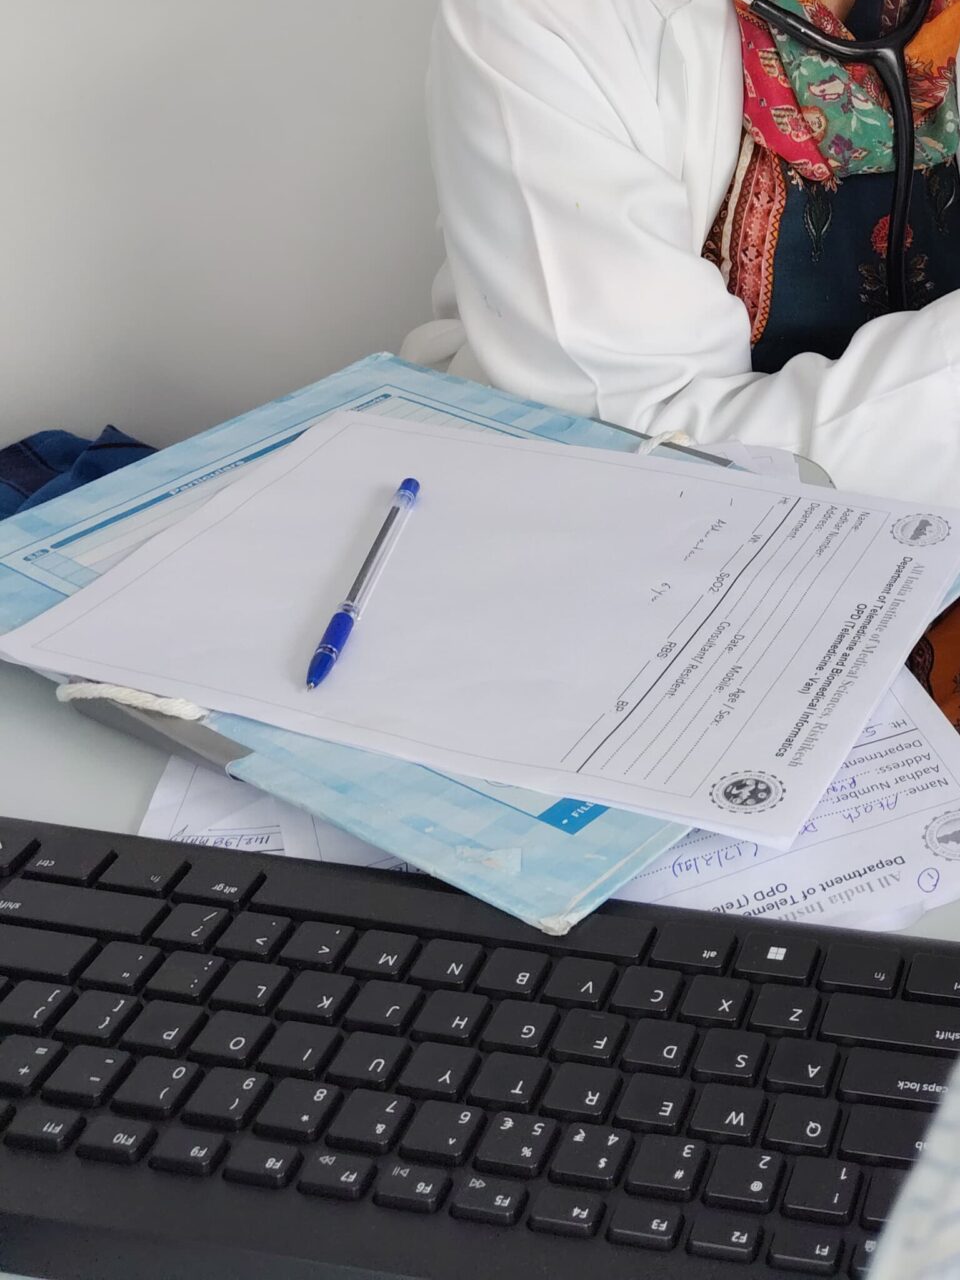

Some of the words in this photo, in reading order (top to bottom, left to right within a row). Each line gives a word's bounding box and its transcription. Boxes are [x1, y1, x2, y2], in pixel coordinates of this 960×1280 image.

[168, 460, 245, 496] Particulars
[880, 555, 913, 595] Department
[912, 562, 926, 576] All
[896, 576, 920, 598] India
[849, 603, 868, 621] OPD
[874, 597, 906, 634] Institute
[845, 604, 884, 652] Telemedicine
[814, 619, 857, 672] (Telemedicine
[835, 651, 851, 667] and
[845, 643, 878, 680] Medical
[796, 676, 821, 696] Van)
[806, 667, 843, 712] Biomedical
[727, 687, 747, 704] Age
[775, 711, 815, 759] Informatics
[788, 720, 829, 768] Rishikesh
[875, 751, 932, 775] Address:
[893, 763, 941, 786] Aadhar
[904, 777, 950, 797] Name:
[818, 854, 907, 889] Department
[877, 870, 902, 889] All
[223, 883, 239, 895] alt
[753, 882, 789, 902] OPD
[800, 886, 817, 902] of
[827, 880, 875, 907] India
[377, 952, 398, 967] M
[701, 949, 718, 959] alt
[446, 962, 464, 976] N
[874, 971, 886, 982] fn
[515, 971, 531, 985] B
[256, 985, 267, 999] L
[580, 980, 593, 994] V
[316, 995, 334, 1009] K
[650, 989, 664, 1003] C
[385, 1005, 401, 1018] J
[717, 998, 734, 1013] X
[451, 1015, 469, 1030] H
[788, 1008, 804, 1022] Z
[162, 1027, 180, 1041] P
[520, 1024, 536, 1039] G
[935, 1030, 960, 1042] shift
[229, 1036, 246, 1051] O
[592, 1036, 608, 1050] F
[302, 1048, 313, 1062] I
[662, 1045, 678, 1060] D
[368, 1058, 386, 1073] U
[735, 1054, 749, 1069] S
[171, 1066, 187, 1080] 0
[437, 1069, 452, 1085] Y
[807, 1063, 822, 1079] A
[242, 1077, 257, 1090] 9
[510, 1079, 524, 1095] T
[896, 1080, 920, 1093] lock
[313, 1088, 328, 1102] 8
[584, 1090, 600, 1106] R
[384, 1100, 398, 1114] 7
[658, 1101, 674, 1117] E
[457, 1111, 472, 1125] 6
[724, 1110, 745, 1127] W
[42, 1121, 64, 1135] F11
[531, 1122, 545, 1136] 5
[805, 1120, 822, 1138] Q
[112, 1132, 137, 1146] F10
[607, 1133, 620, 1147] 4
[189, 1145, 209, 1158] F9
[682, 1144, 696, 1158] 3
[264, 1157, 284, 1170] F8
[758, 1155, 772, 1170] 2
[339, 1170, 358, 1183] F7
[415, 1181, 434, 1195] F6
[493, 1194, 512, 1208] F5
[571, 1206, 590, 1220] F4
[650, 1218, 669, 1232] F3
[730, 1230, 749, 1244] F2
[814, 1243, 830, 1257] F1
